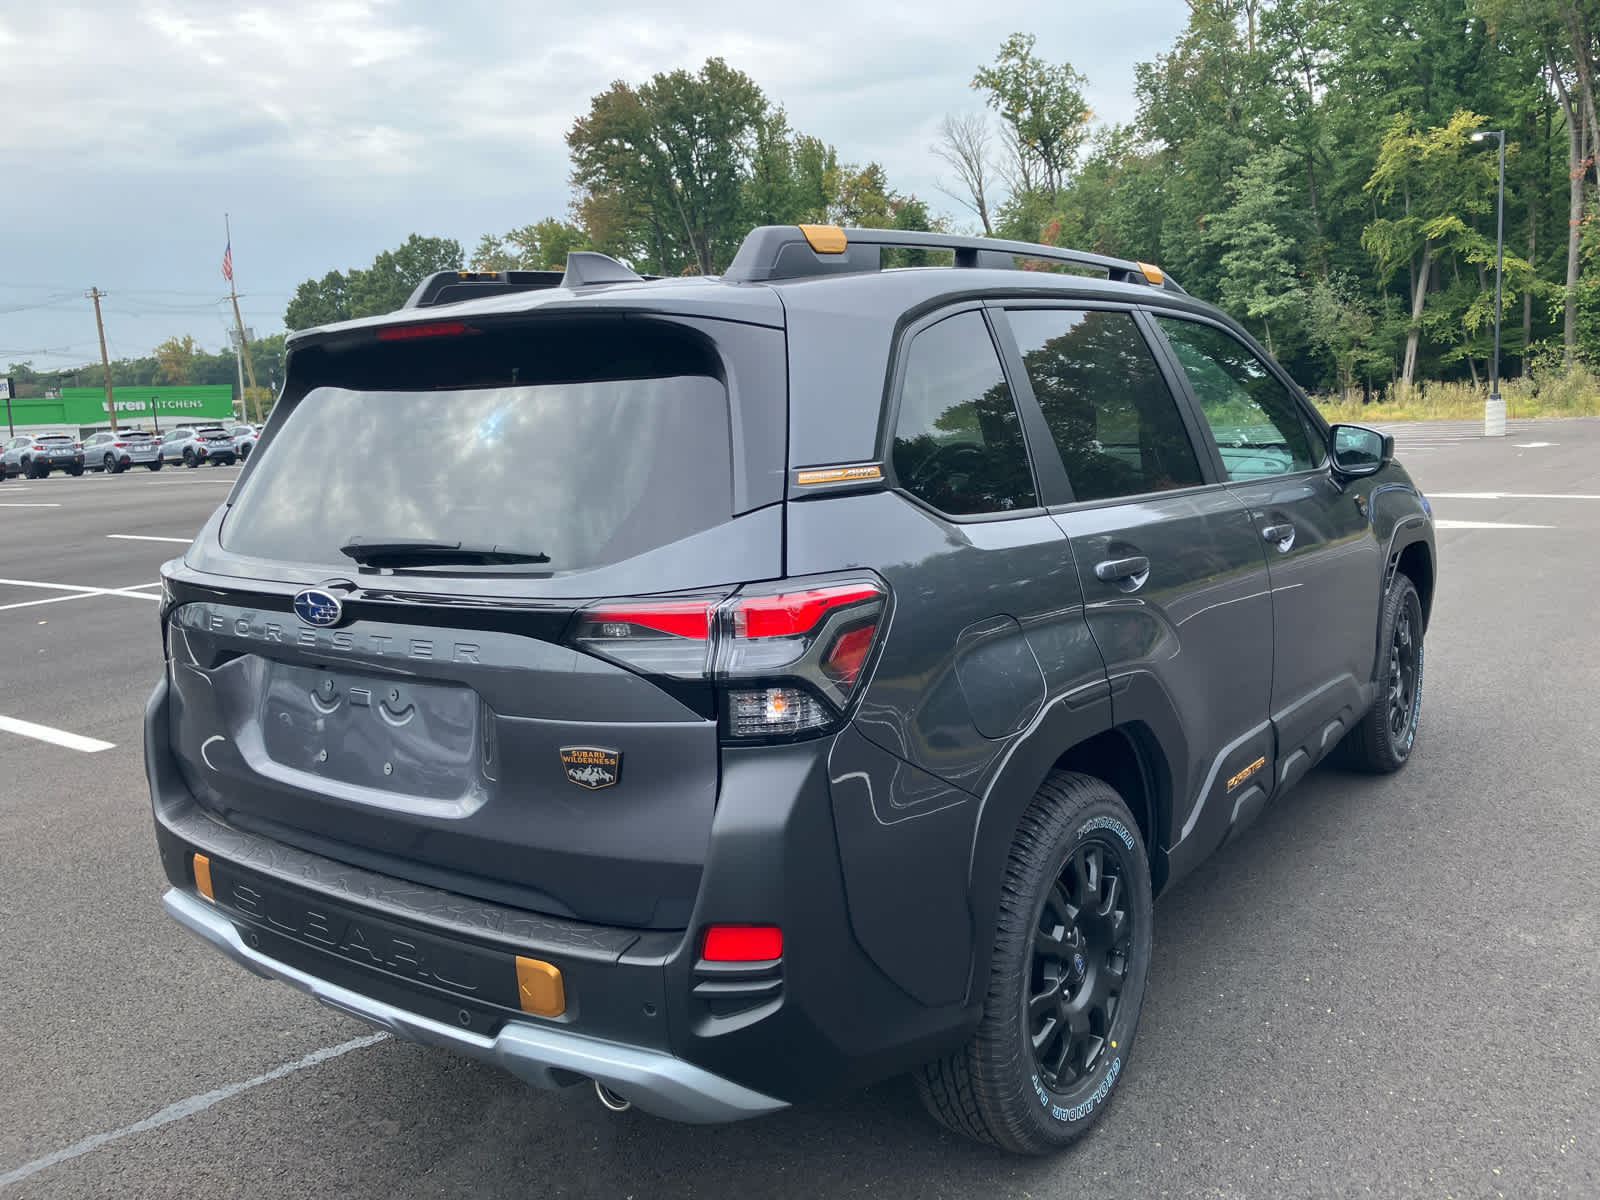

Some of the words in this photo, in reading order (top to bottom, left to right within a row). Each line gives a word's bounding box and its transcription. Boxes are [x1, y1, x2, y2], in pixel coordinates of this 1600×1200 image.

[208, 613, 482, 664] FORESTER
[563, 755, 616, 765] WILDERNESS
[571, 751, 605, 759] SUBARU
[232, 881, 478, 990] SUBARU
[1052, 1057, 1121, 1121] GEOLANDAR
